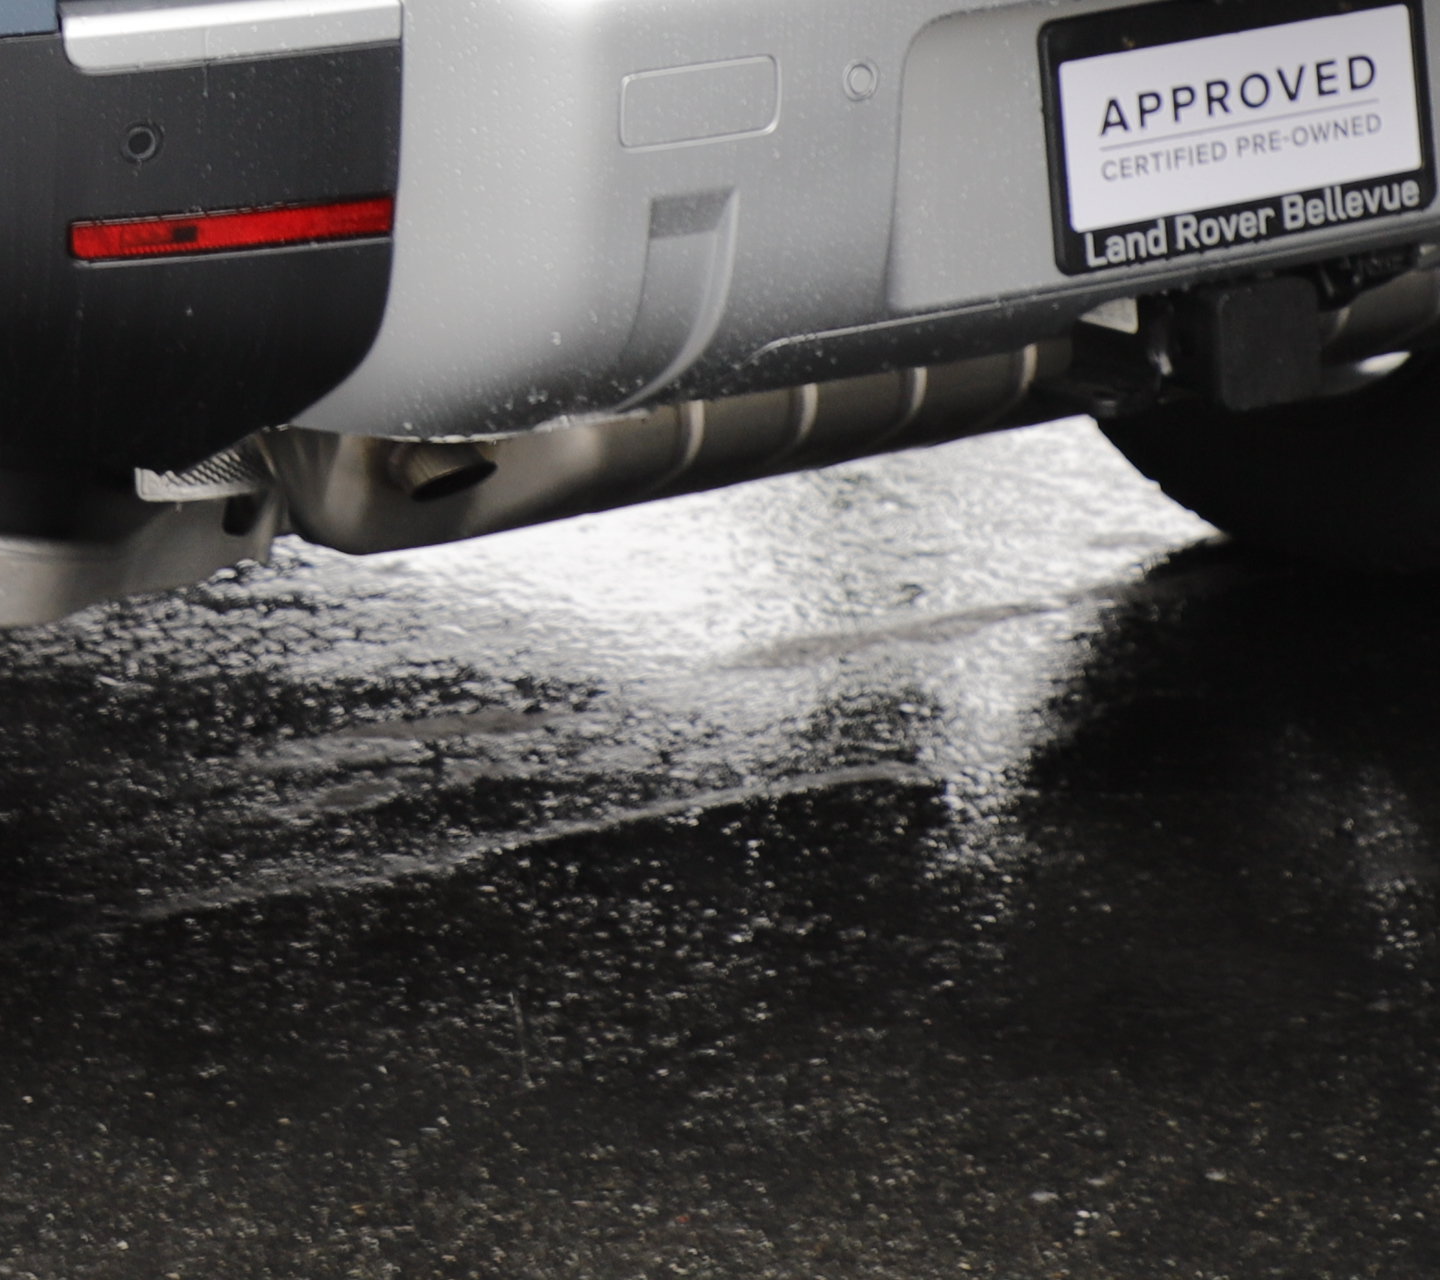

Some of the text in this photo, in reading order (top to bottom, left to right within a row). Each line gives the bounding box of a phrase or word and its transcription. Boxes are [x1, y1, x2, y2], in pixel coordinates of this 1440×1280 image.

[1097, 54, 1377, 137] APPROVED
[1100, 113, 1382, 182] CERTIFIED PRE-OWNED
[1083, 178, 1421, 268] Land Rover Bellevue
